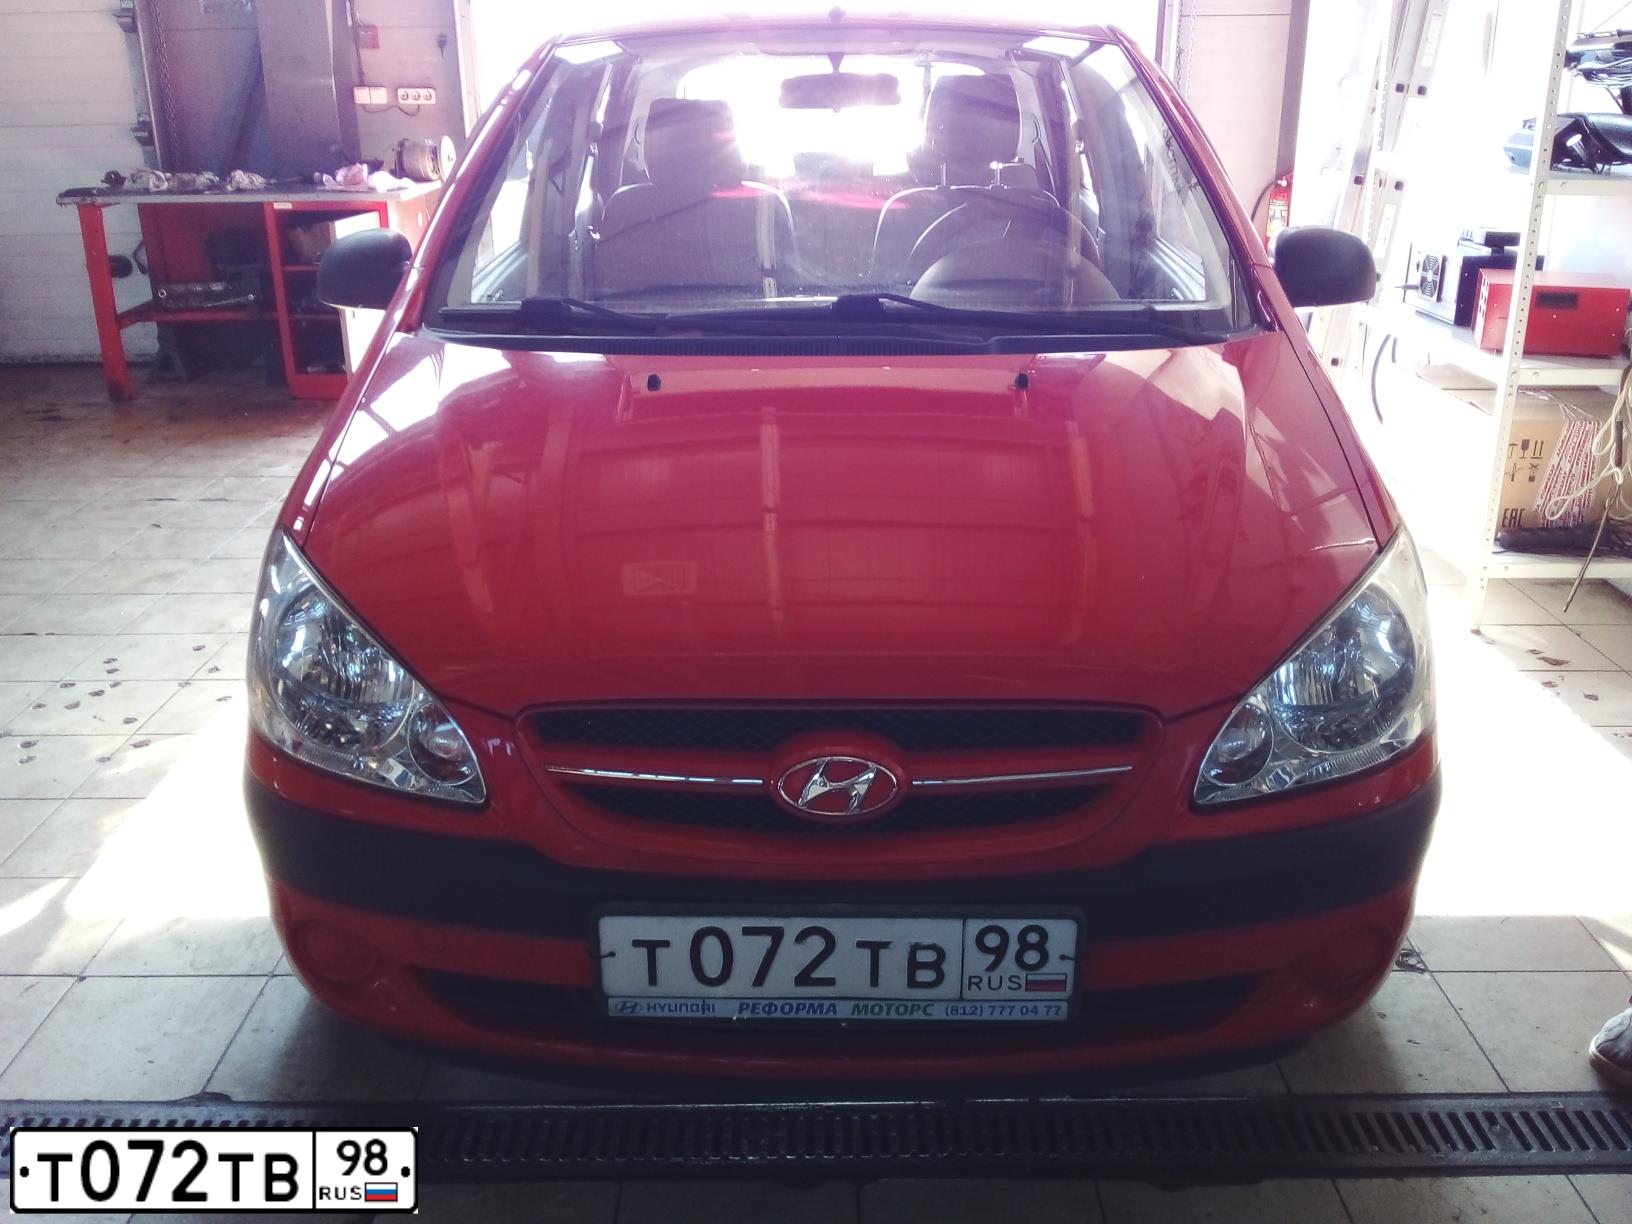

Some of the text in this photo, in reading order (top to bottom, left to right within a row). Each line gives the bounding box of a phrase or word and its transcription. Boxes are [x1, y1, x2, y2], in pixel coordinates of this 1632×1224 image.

[632, 924, 1050, 989] Т072ТВ 98
[967, 975, 1023, 992] RUS
[738, 1001, 838, 1017] РЕФОРМА
[851, 1003, 935, 1017] МОТОРС
[945, 1003, 984, 1017] (812)
[989, 1004, 1016, 1016] 777
[1020, 1004, 1040, 1016] 04
[1045, 1005, 1063, 1016] 77
